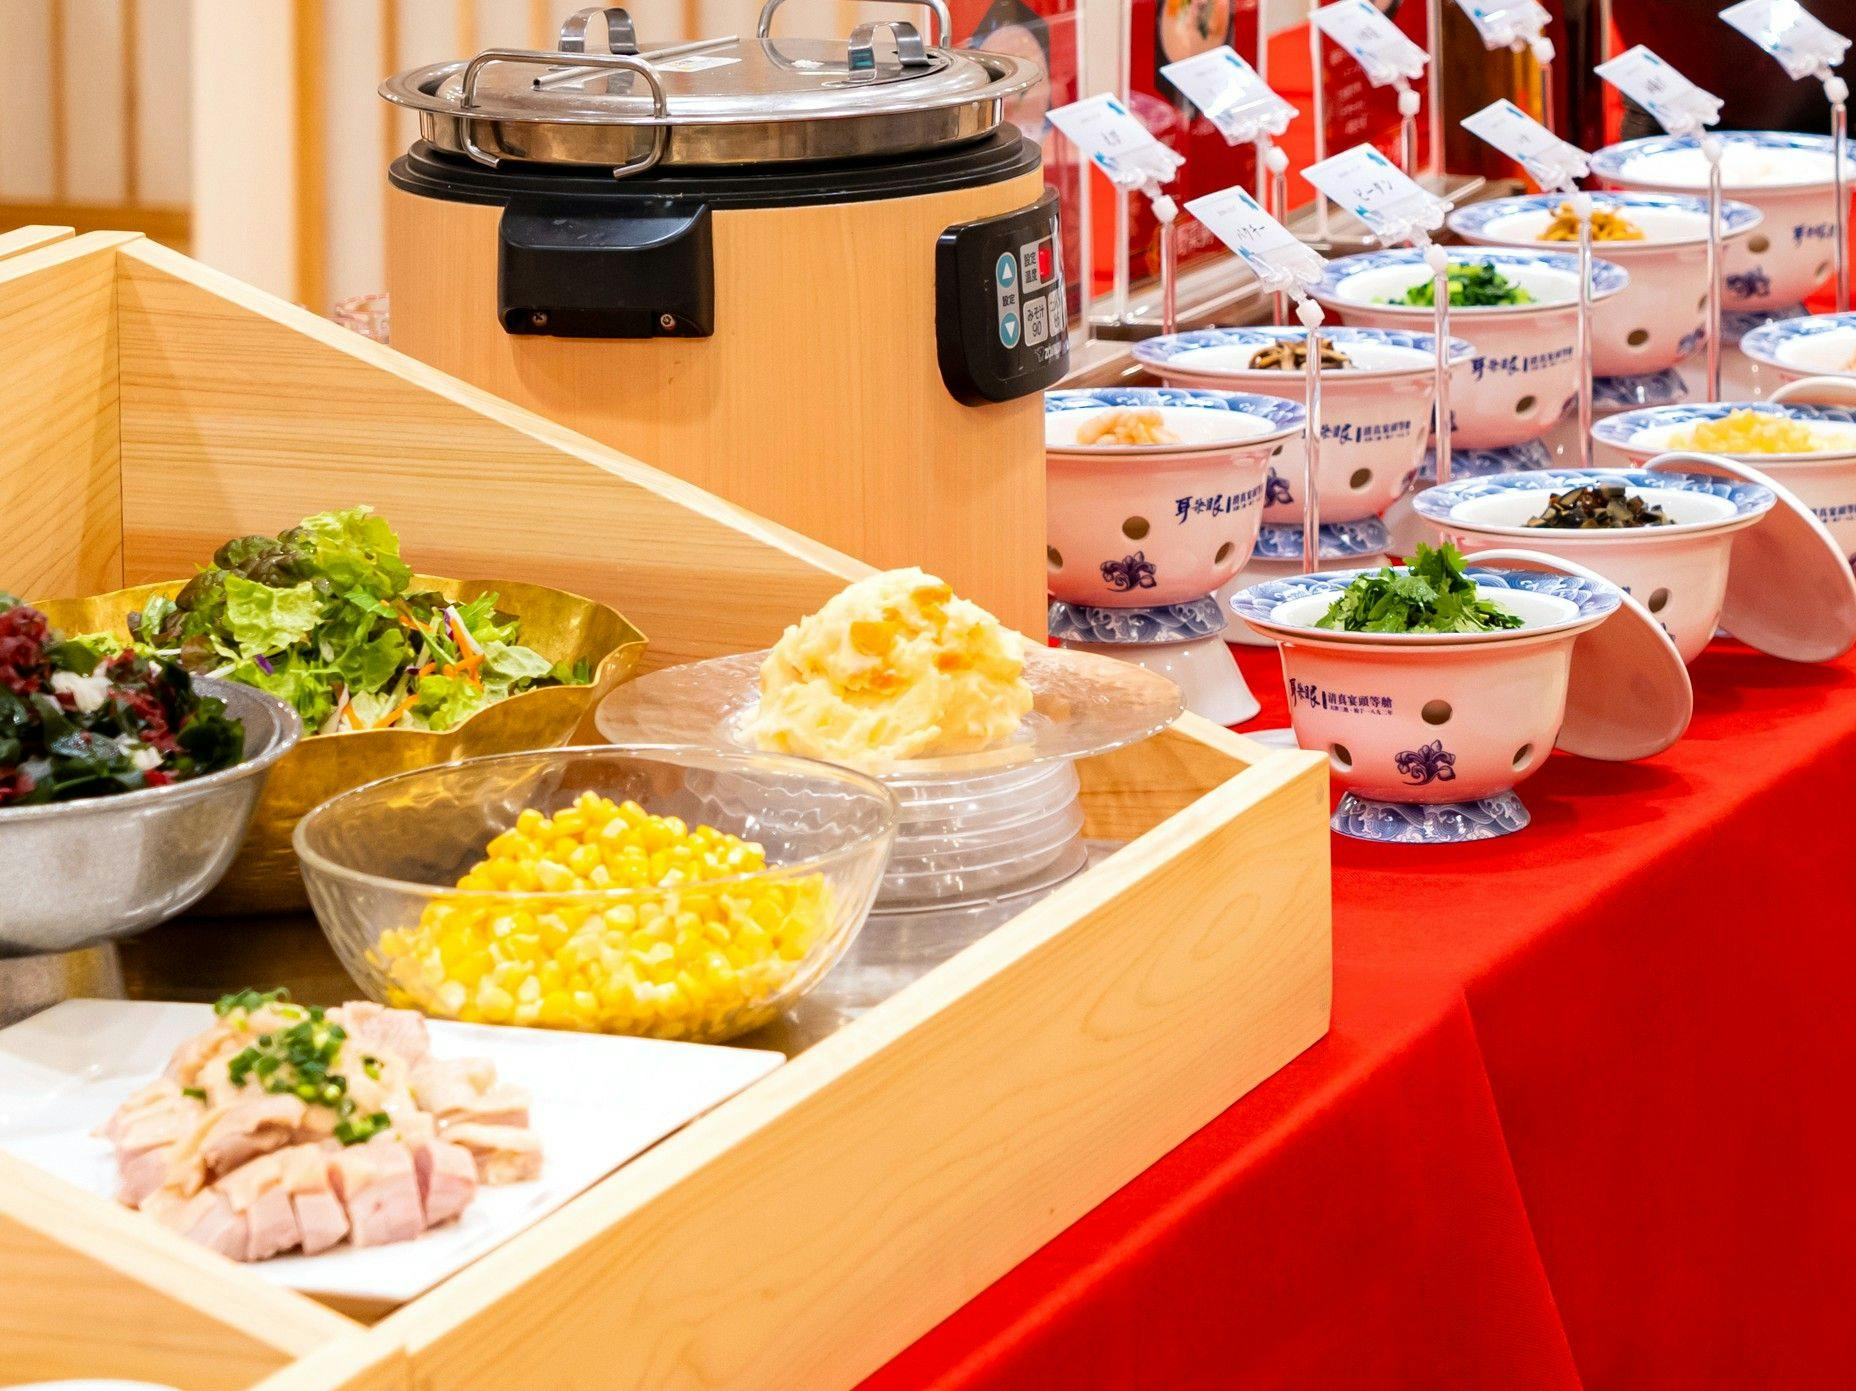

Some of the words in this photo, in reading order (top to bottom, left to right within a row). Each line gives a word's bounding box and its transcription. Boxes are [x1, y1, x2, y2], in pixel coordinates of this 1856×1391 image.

[1002, 294, 1016, 307] 設定
[1027, 305, 1044, 322] みそ汁
[1032, 320, 1043, 337] 90
